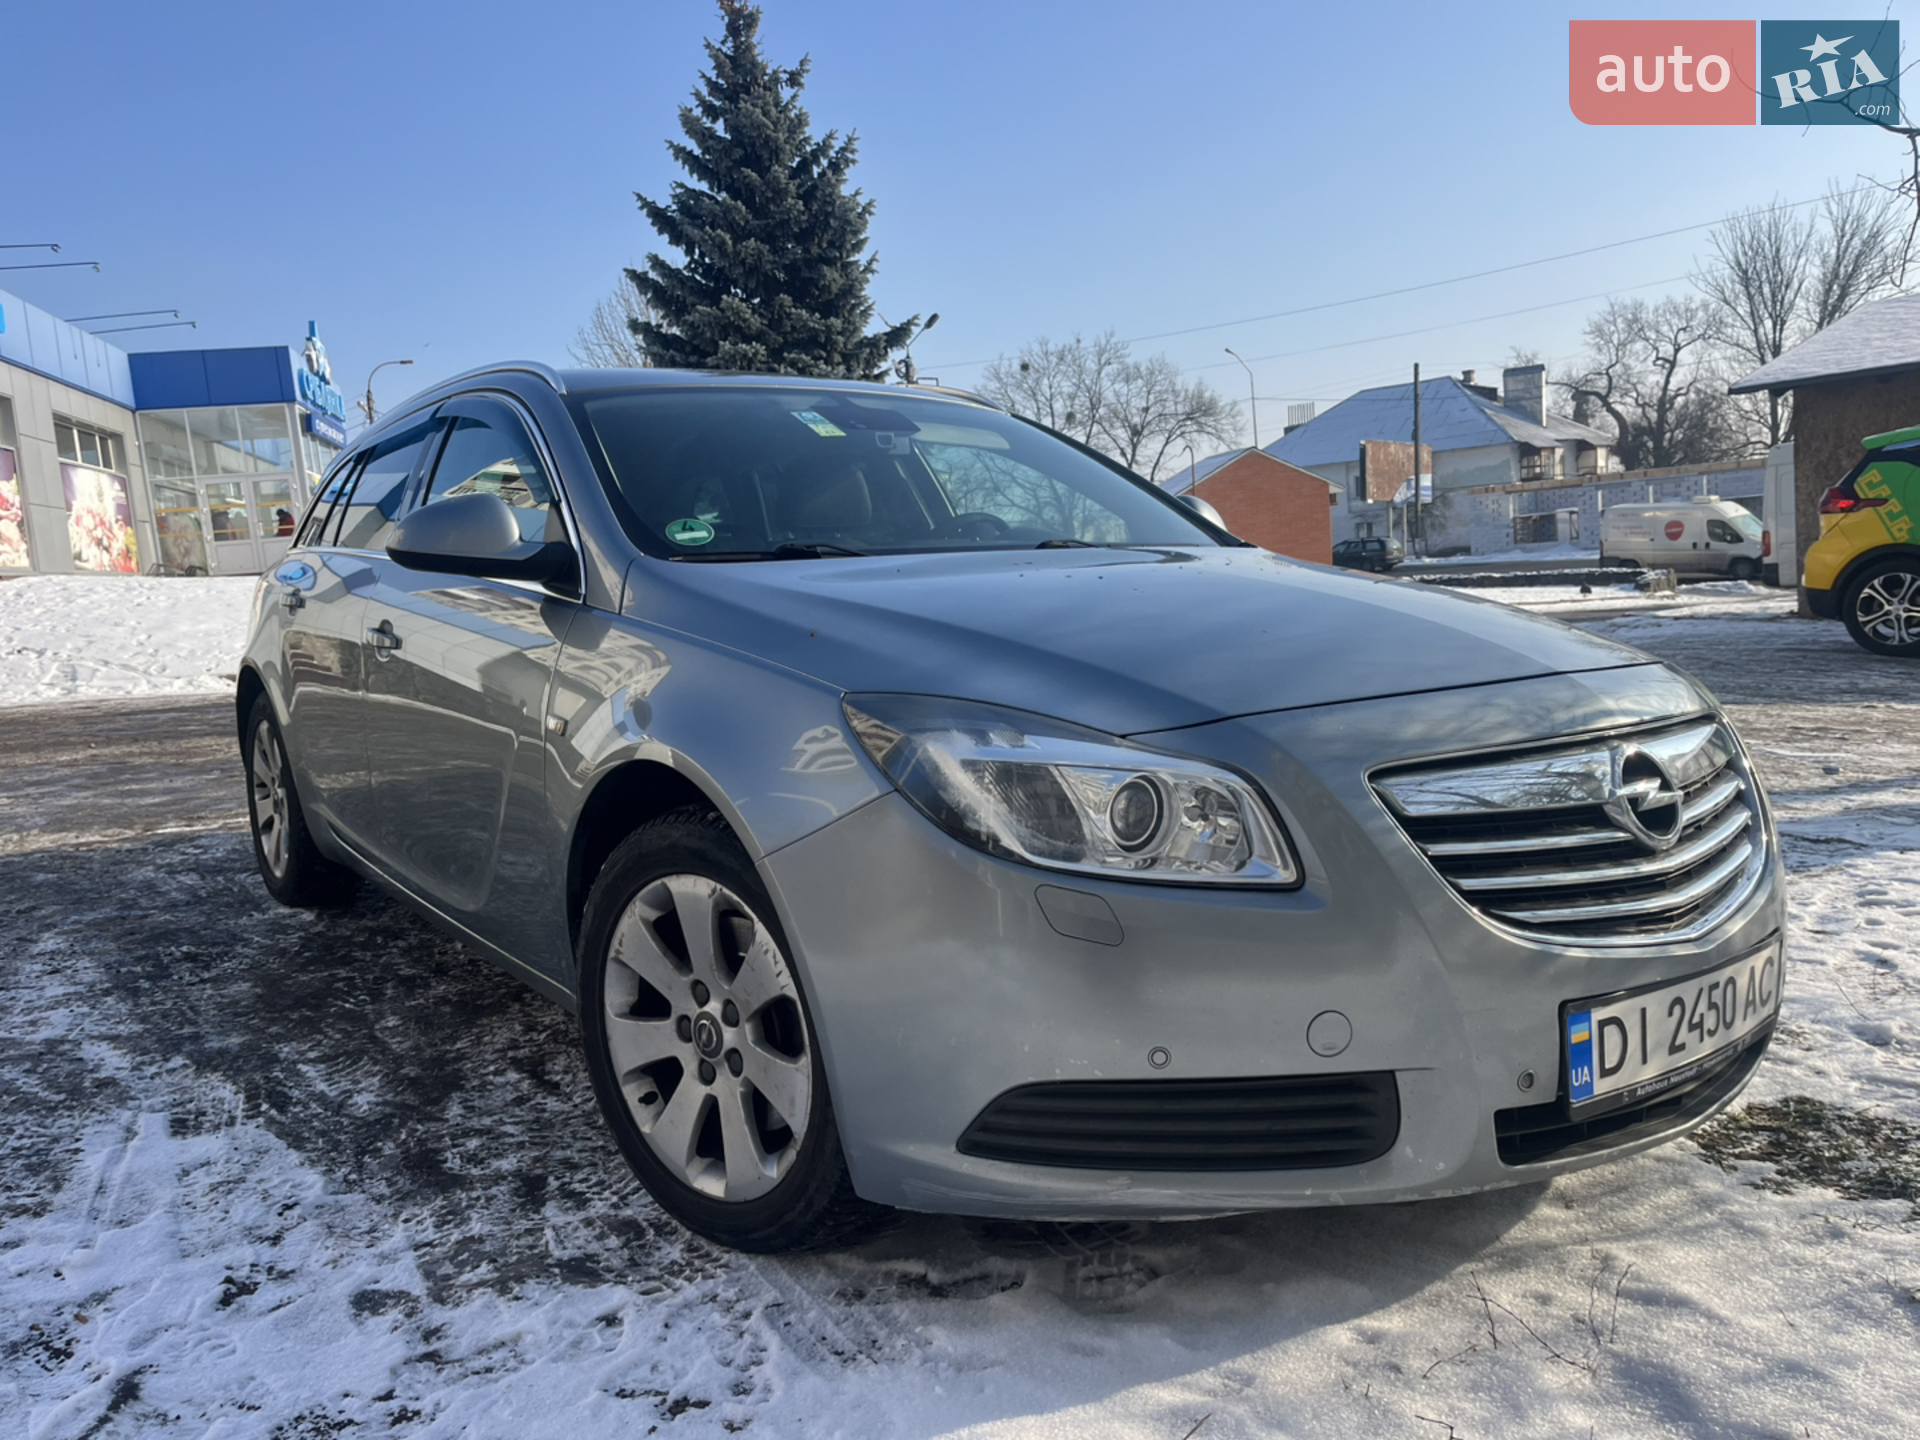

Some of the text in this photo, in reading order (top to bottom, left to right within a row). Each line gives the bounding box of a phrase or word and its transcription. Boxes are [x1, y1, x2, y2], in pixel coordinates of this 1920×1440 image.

[1668, 977, 1736, 1055] 2450
[1572, 1065, 1591, 1087] UA
[1636, 1079, 1669, 1097] Autohaus
